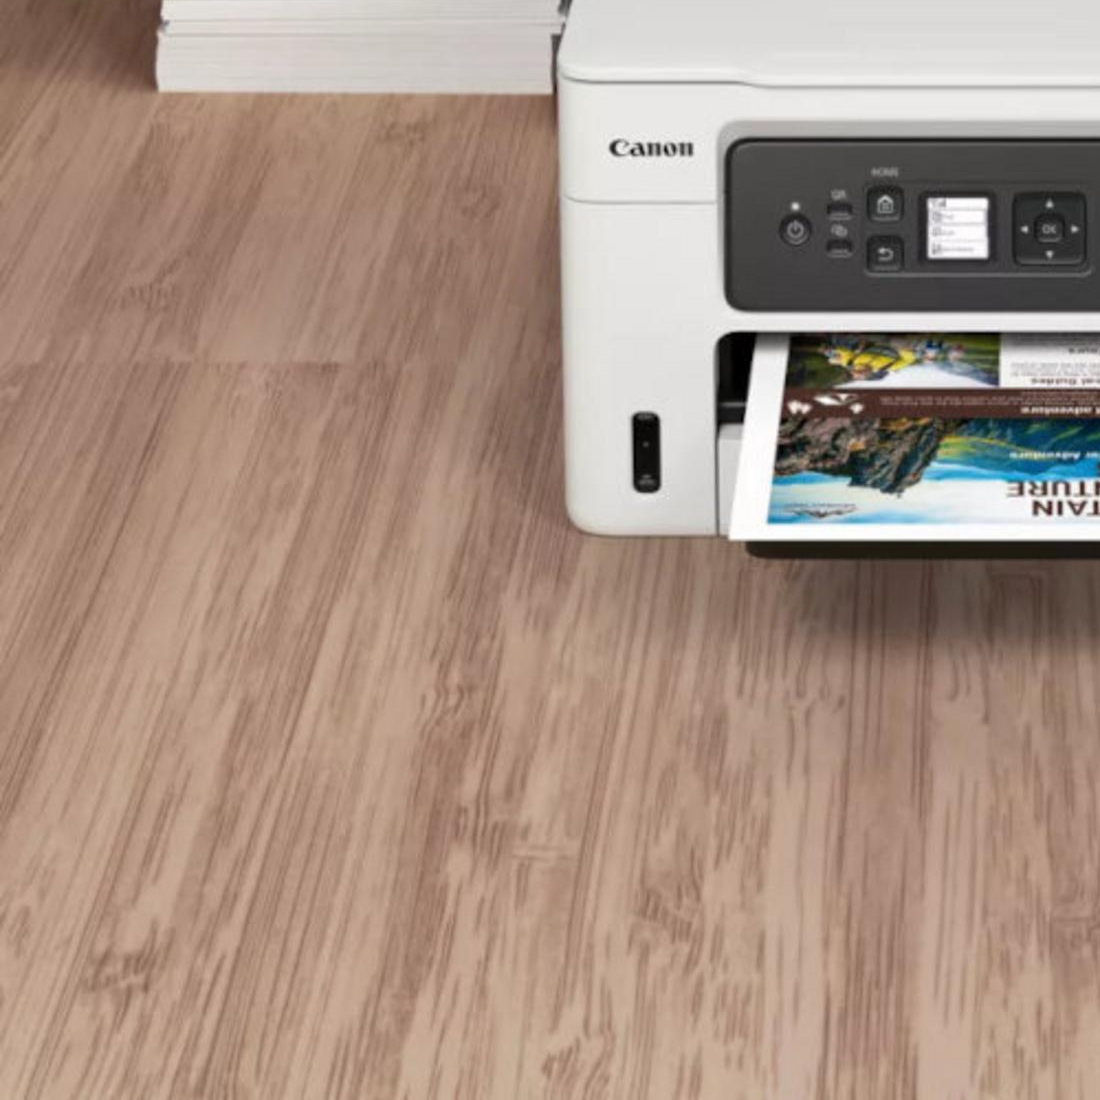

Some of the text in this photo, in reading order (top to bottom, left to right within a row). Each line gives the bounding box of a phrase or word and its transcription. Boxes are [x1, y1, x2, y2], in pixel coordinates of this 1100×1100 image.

[608, 138, 694, 157] Canon
[1041, 224, 1057, 235] OK
[1020, 406, 1092, 415] adventure
[1009, 451, 1081, 460] Adventure
